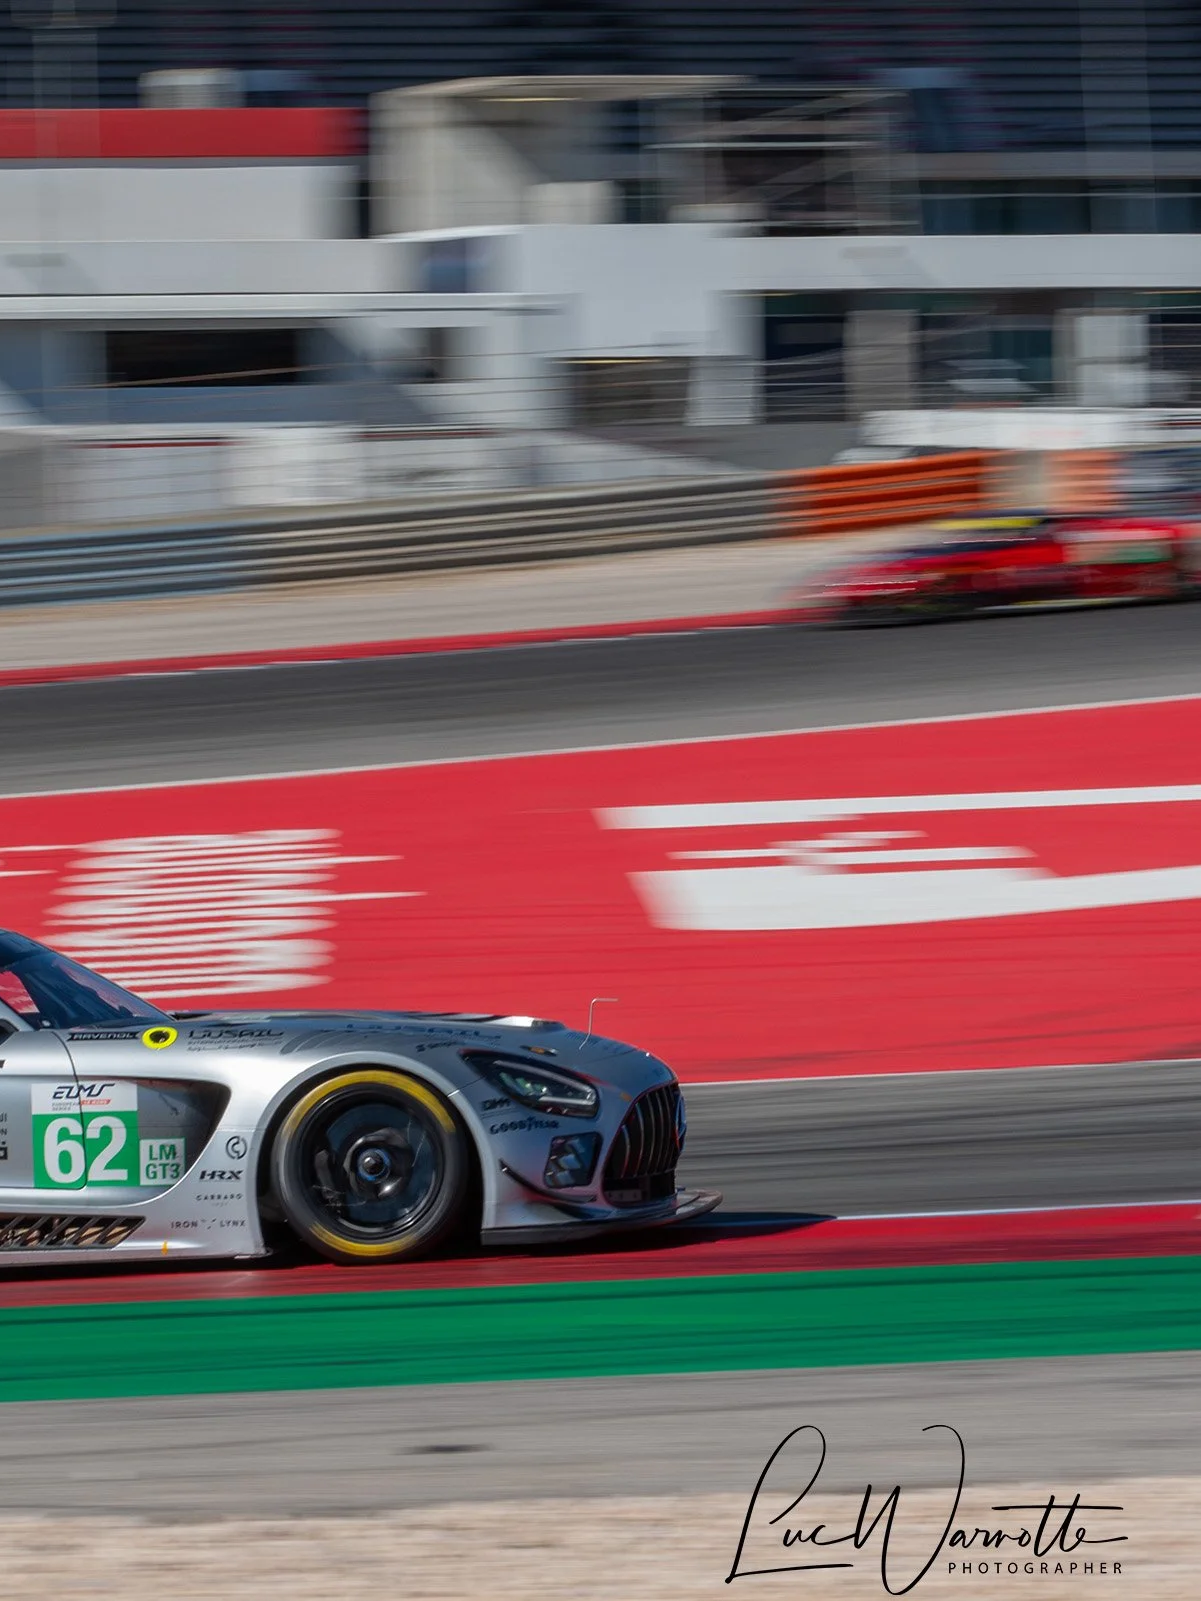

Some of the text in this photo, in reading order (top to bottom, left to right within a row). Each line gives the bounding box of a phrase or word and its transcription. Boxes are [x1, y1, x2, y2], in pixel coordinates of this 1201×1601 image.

[52, 1083, 116, 1099] ELMS
[43, 1115, 129, 1184] 62
[149, 1144, 176, 1161] LM
[145, 1163, 181, 1180] GT3
[199, 1170, 244, 1180] HRX
[171, 1219, 246, 1229] IRON LYNX
